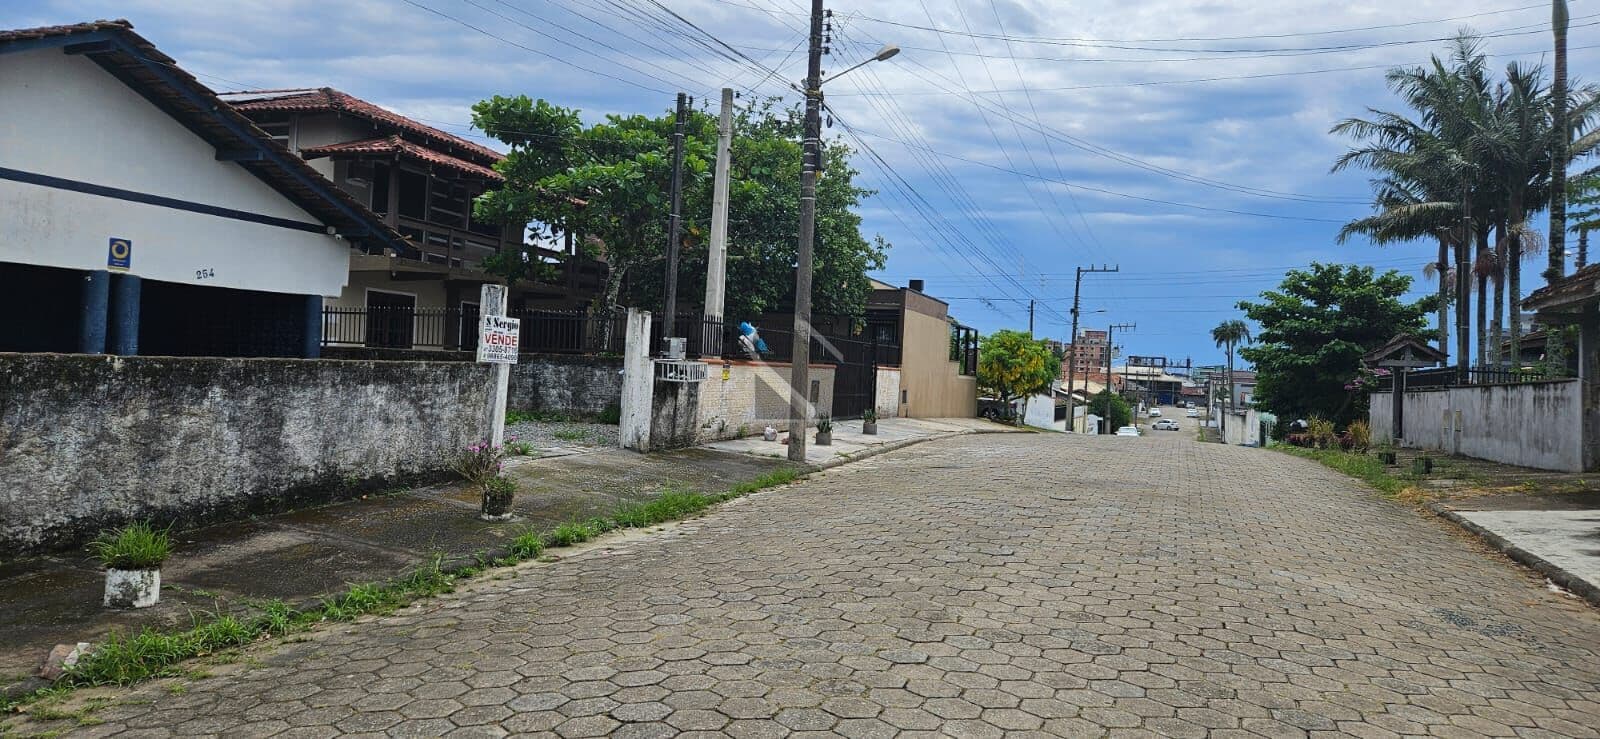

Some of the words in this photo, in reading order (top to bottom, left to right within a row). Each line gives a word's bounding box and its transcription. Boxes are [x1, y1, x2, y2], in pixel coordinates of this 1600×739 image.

[196, 268, 215, 280] 254
[493, 317, 518, 331] Sergio
[485, 333, 517, 346] VENDE
